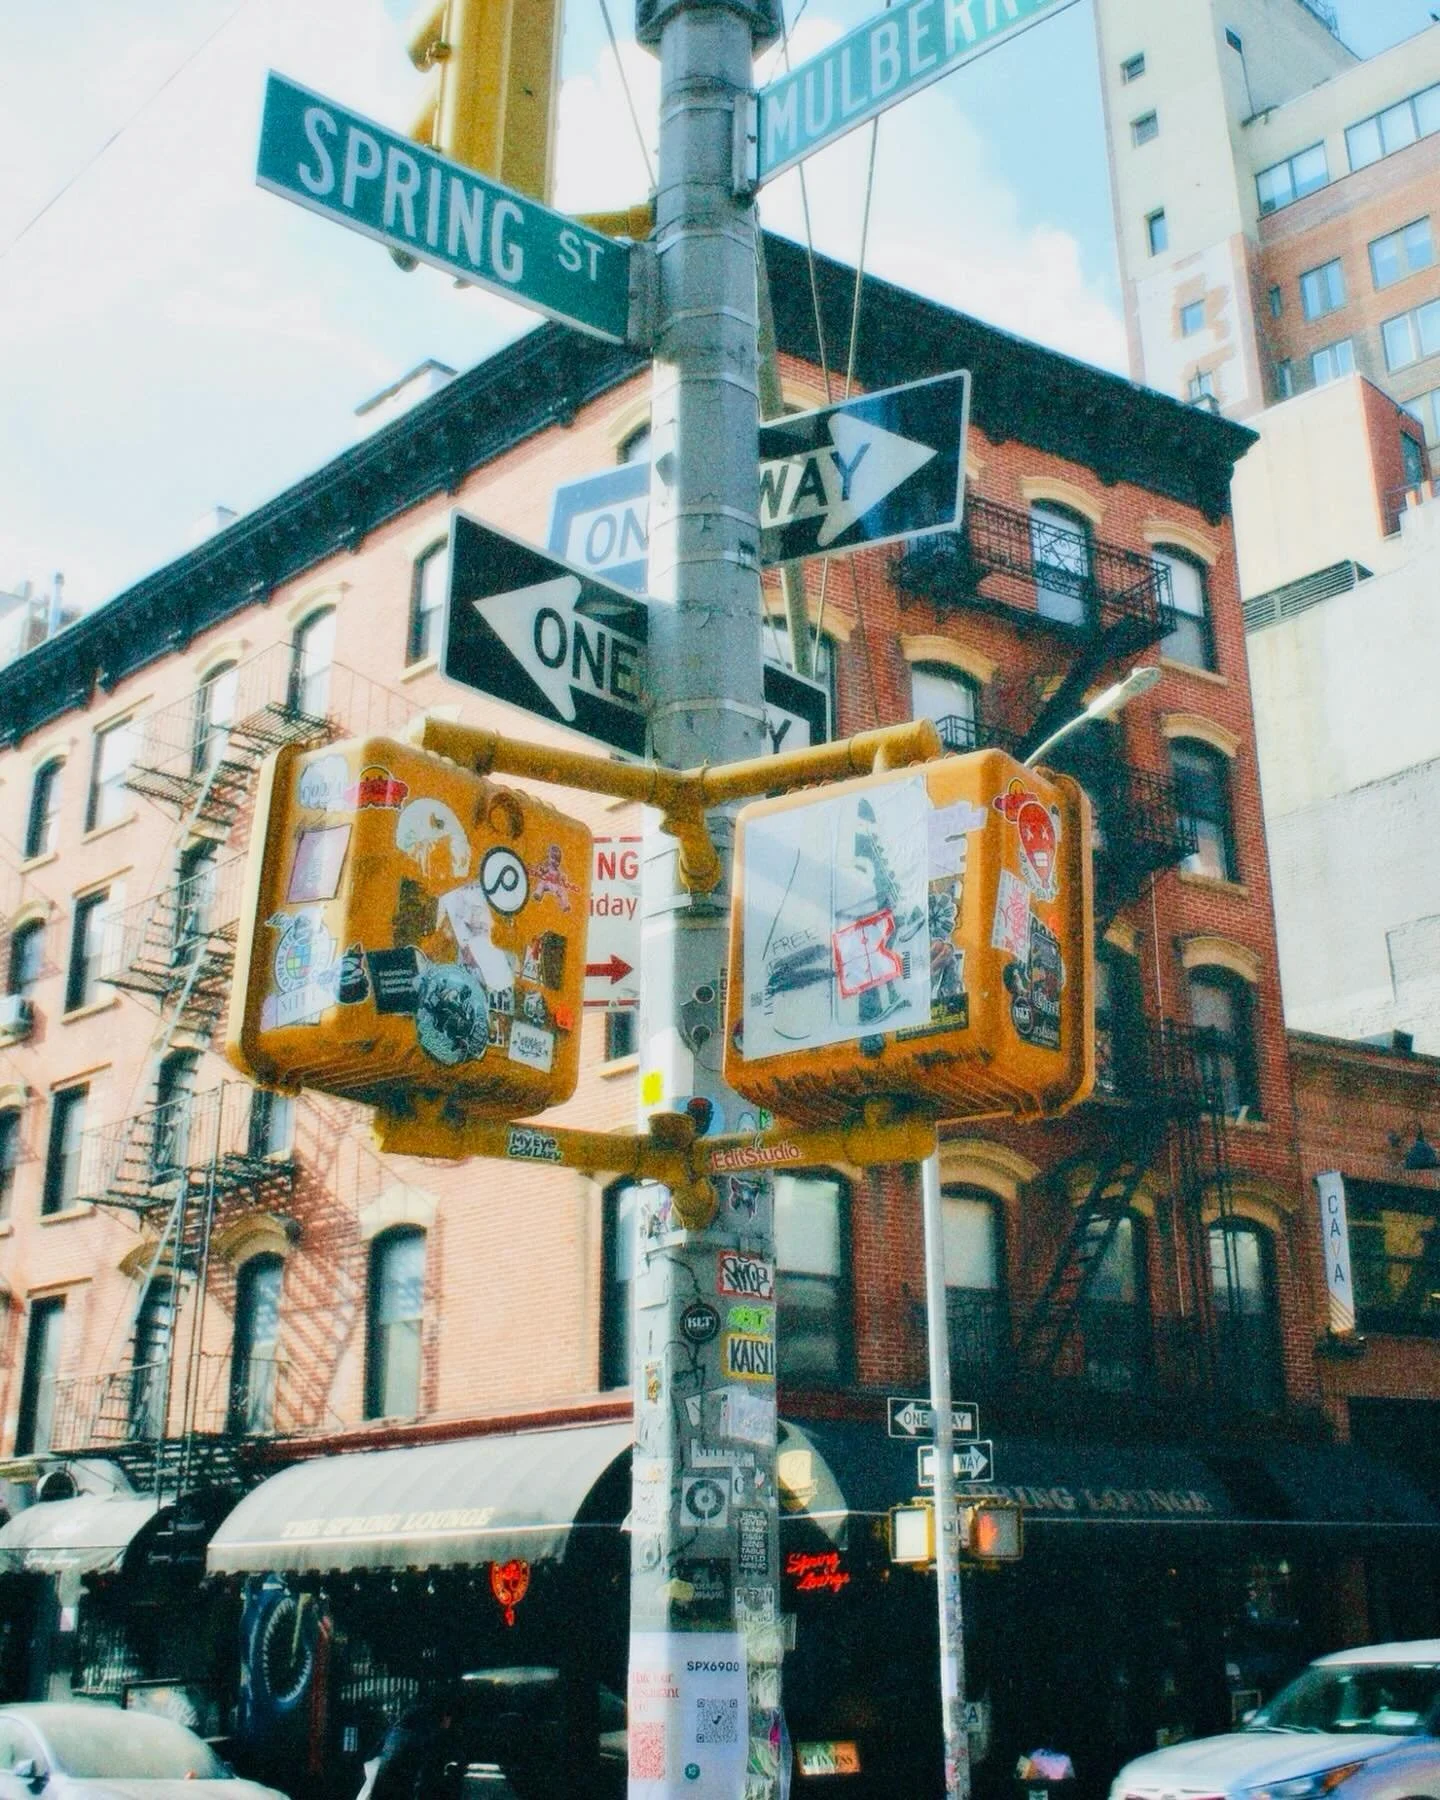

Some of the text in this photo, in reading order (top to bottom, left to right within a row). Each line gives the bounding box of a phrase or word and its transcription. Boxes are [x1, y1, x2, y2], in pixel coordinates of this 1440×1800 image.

[299, 107, 605, 284] SPRING ST
[533, 607, 640, 701] ONE
[590, 893, 638, 921] iday
[1328, 1195, 1345, 1284] CAVA
[903, 1411, 929, 1426] ONE
[960, 1455, 981, 1470] WAY
[280, 1506, 496, 1538] THE SPRING LOUNGE
[687, 1661, 740, 1672] SPX6900
